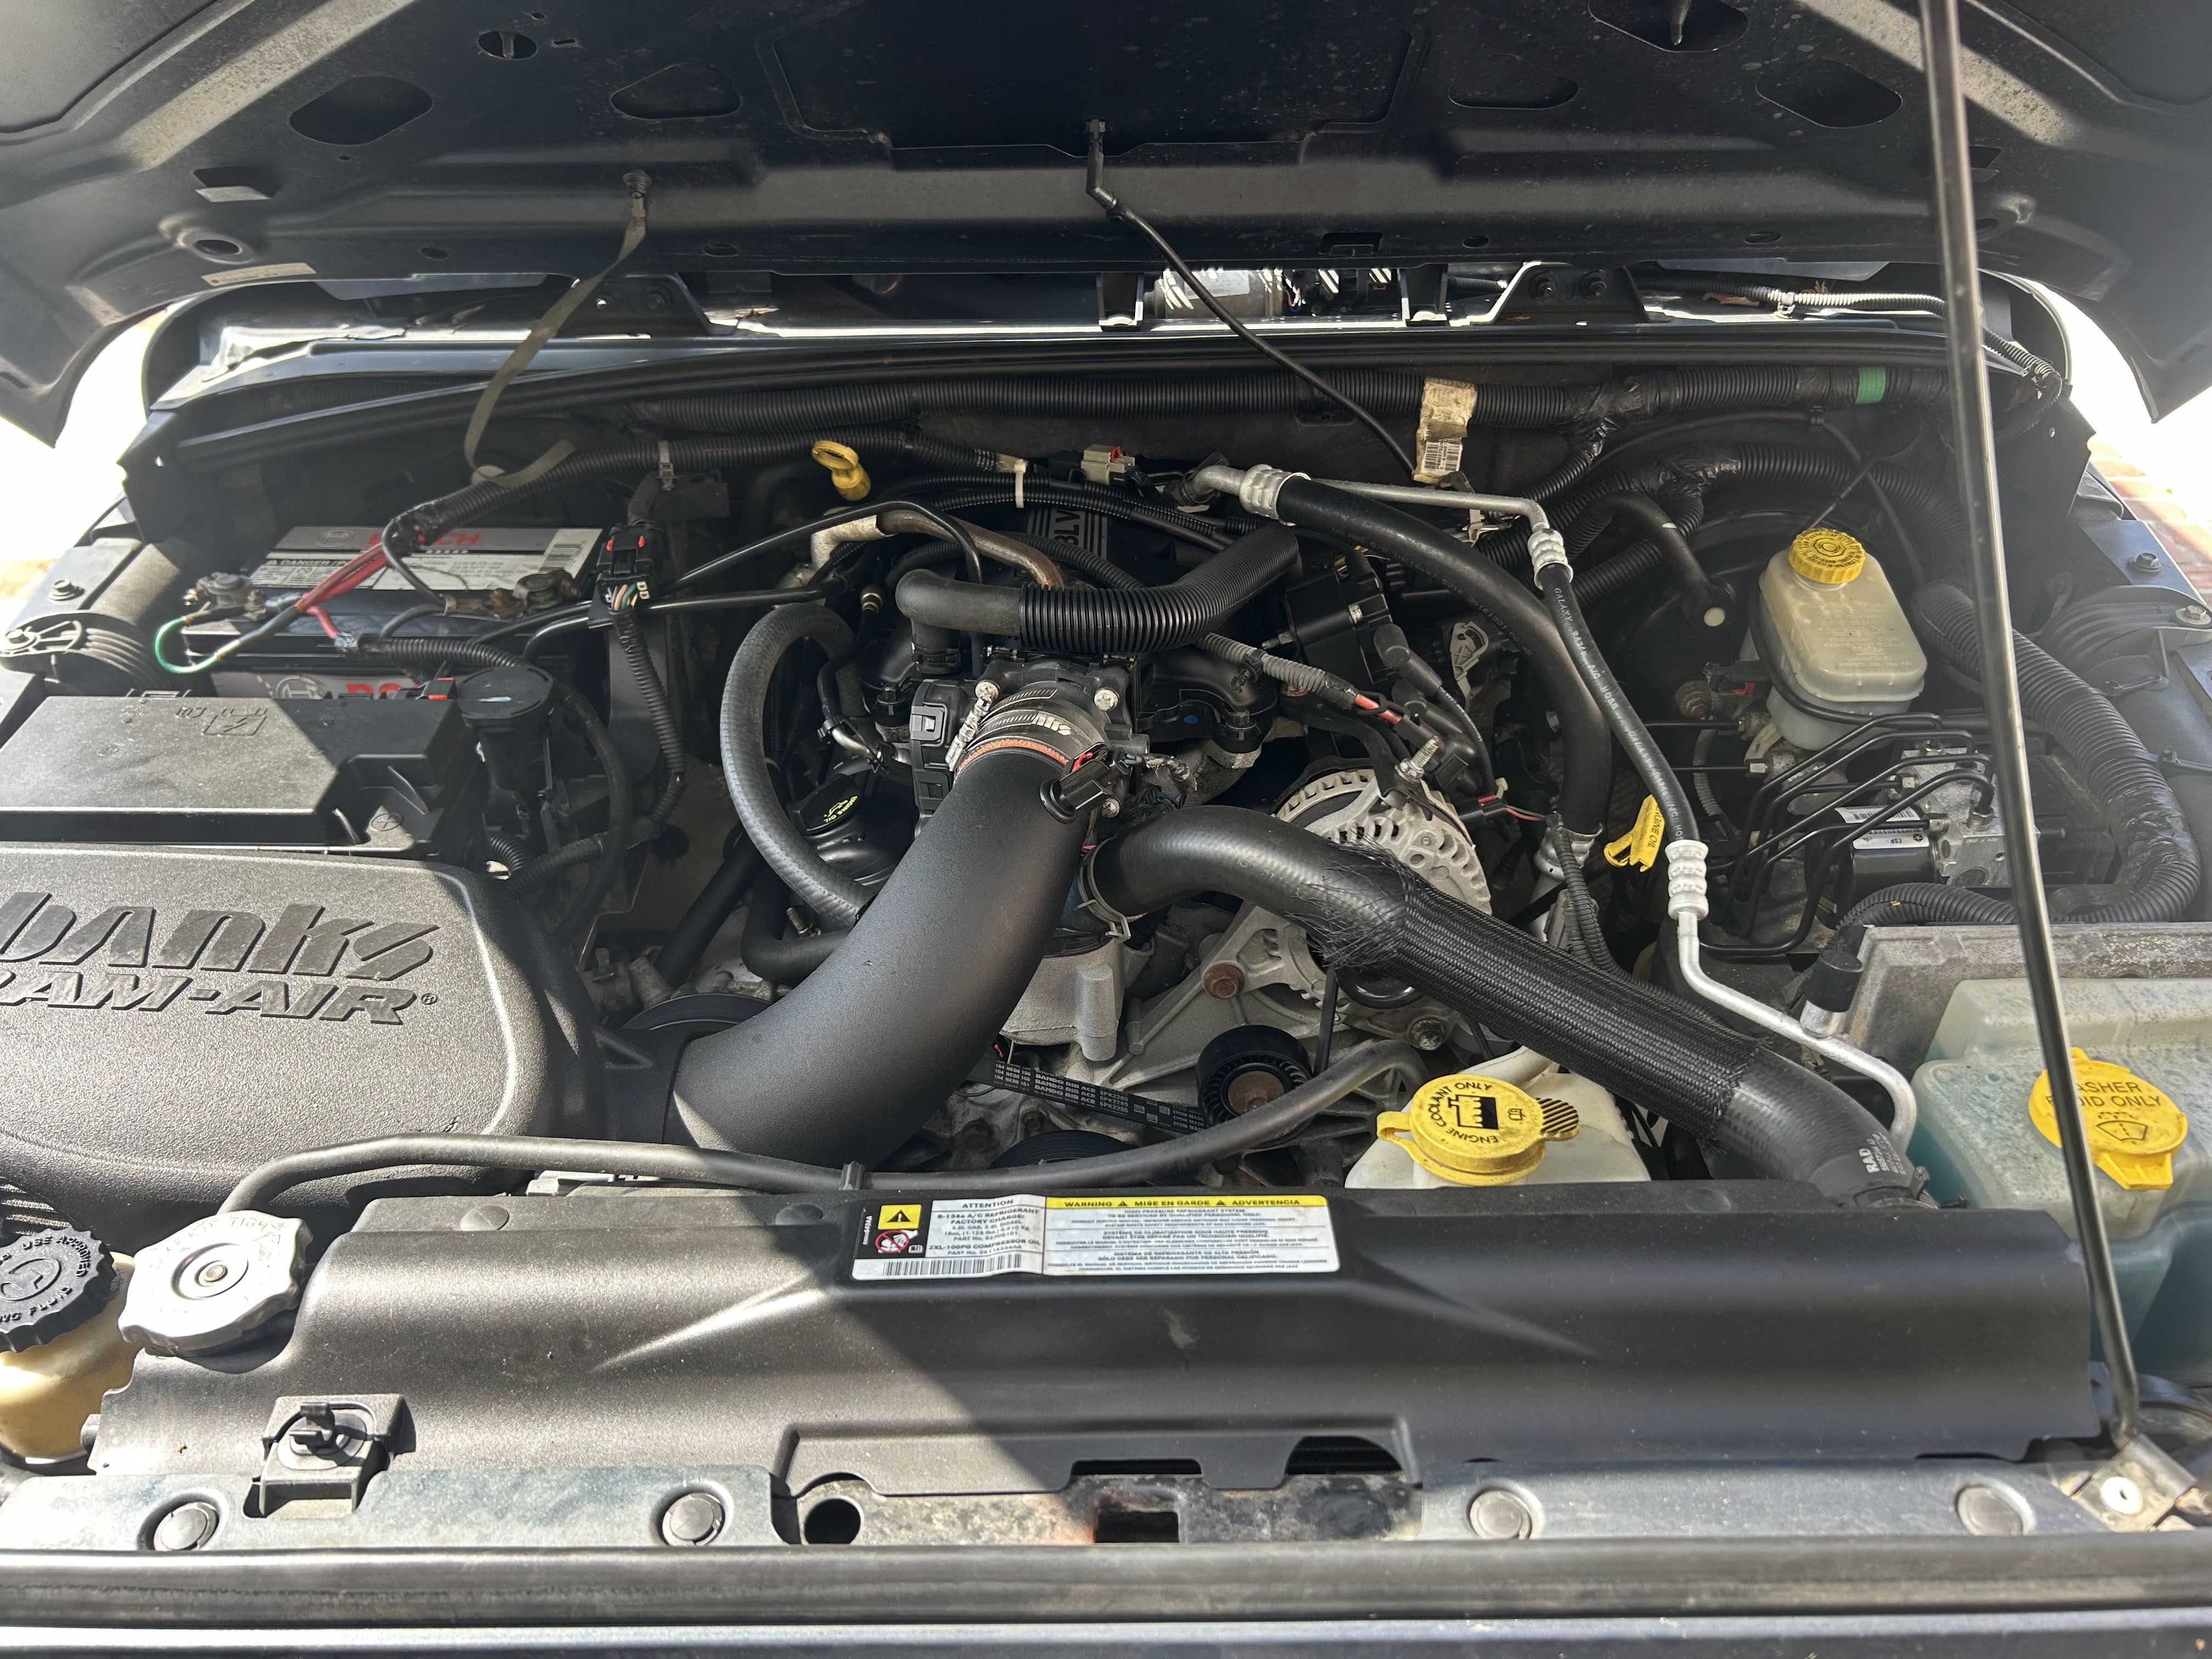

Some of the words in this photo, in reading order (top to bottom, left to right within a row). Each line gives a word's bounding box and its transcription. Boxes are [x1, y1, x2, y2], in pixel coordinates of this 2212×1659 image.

[1554, 588, 1573, 622] GALAXY
[1601, 686, 1620, 710] HOSE
[1647, 834, 1657, 849] OIL
[1035, 1073, 1064, 1084] BANDO
[1034, 1084, 1063, 1096] BANDO
[1035, 1079, 1064, 1090] BANDO
[1454, 1081, 1492, 1091] ONLY
[1099, 1090, 1128, 1102] 6PK2285
[1099, 1096, 1128, 1107] 6PK2285
[2110, 1096, 2161, 1107] ONLY
[1099, 1102, 1128, 1113] 6PK2285
[1427, 1085, 1452, 1127] COOLANT
[1446, 1127, 1499, 1143] ENGINE
[1858, 1148, 1880, 1172] RAD
[962, 1199, 1014, 1209] ATTENTION
[985, 1208, 1040, 1218] REFRIGERANT
[973, 1238, 1026, 1249] COMPRESSOR
[22, 1235, 54, 1250] USE
[56, 1235, 91, 1278] APPROVED
